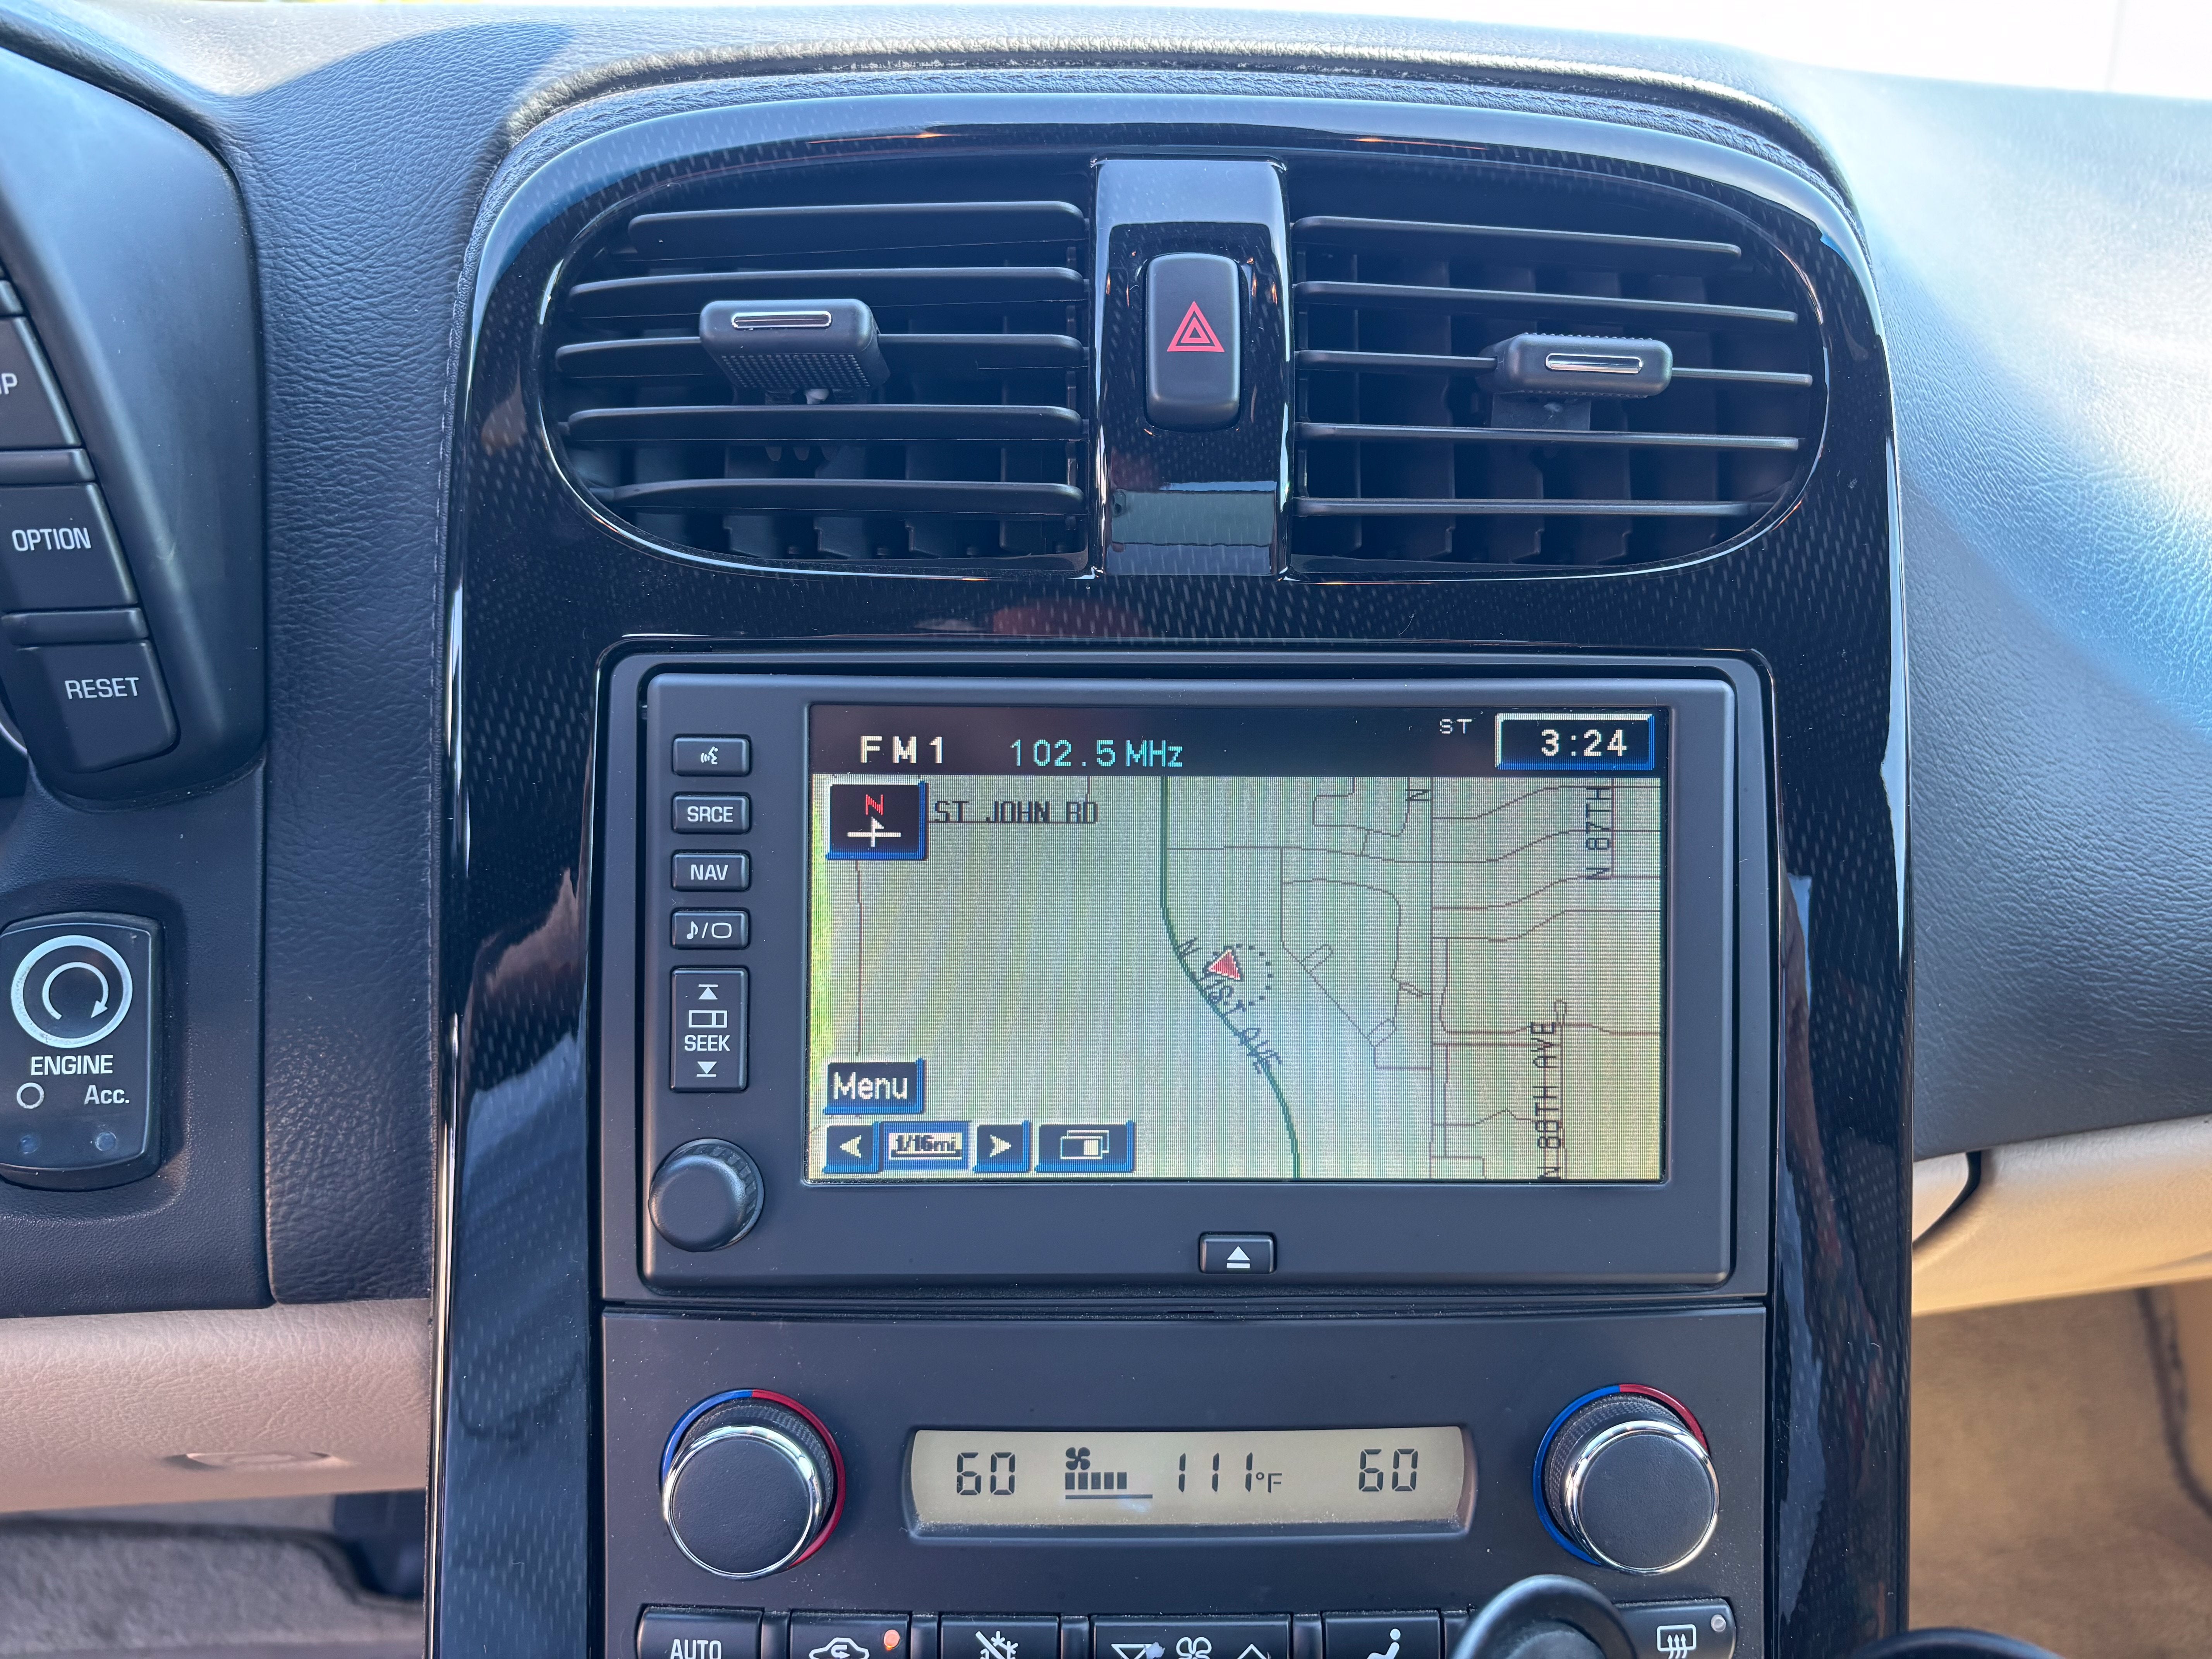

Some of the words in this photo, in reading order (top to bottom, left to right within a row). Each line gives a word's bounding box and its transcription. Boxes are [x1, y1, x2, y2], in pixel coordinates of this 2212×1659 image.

[12, 527, 91, 551] OPTION
[65, 677, 139, 699] RESET
[1439, 718, 1473, 735] ST
[1540, 729, 1628, 757] 3:24
[687, 805, 733, 823] SRCE
[865, 793, 884, 815] N
[934, 800, 969, 824] ST
[986, 800, 1050, 824] JOHN
[1068, 800, 1098, 824] RD
[1585, 787, 1610, 852] 87TH
[690, 864, 729, 881] NAV
[1585, 867, 1610, 880] N
[684, 1034, 730, 1051] SEEK
[1531, 1022, 1559, 1068] AVE
[31, 1054, 113, 1075] ENGINE
[84, 1084, 130, 1105] Acc.
[833, 1072, 908, 1099] Menu
[956, 1451, 1016, 1496] 60
[1358, 1448, 1418, 1492] 60
[670, 1639, 722, 1659] AUTO
